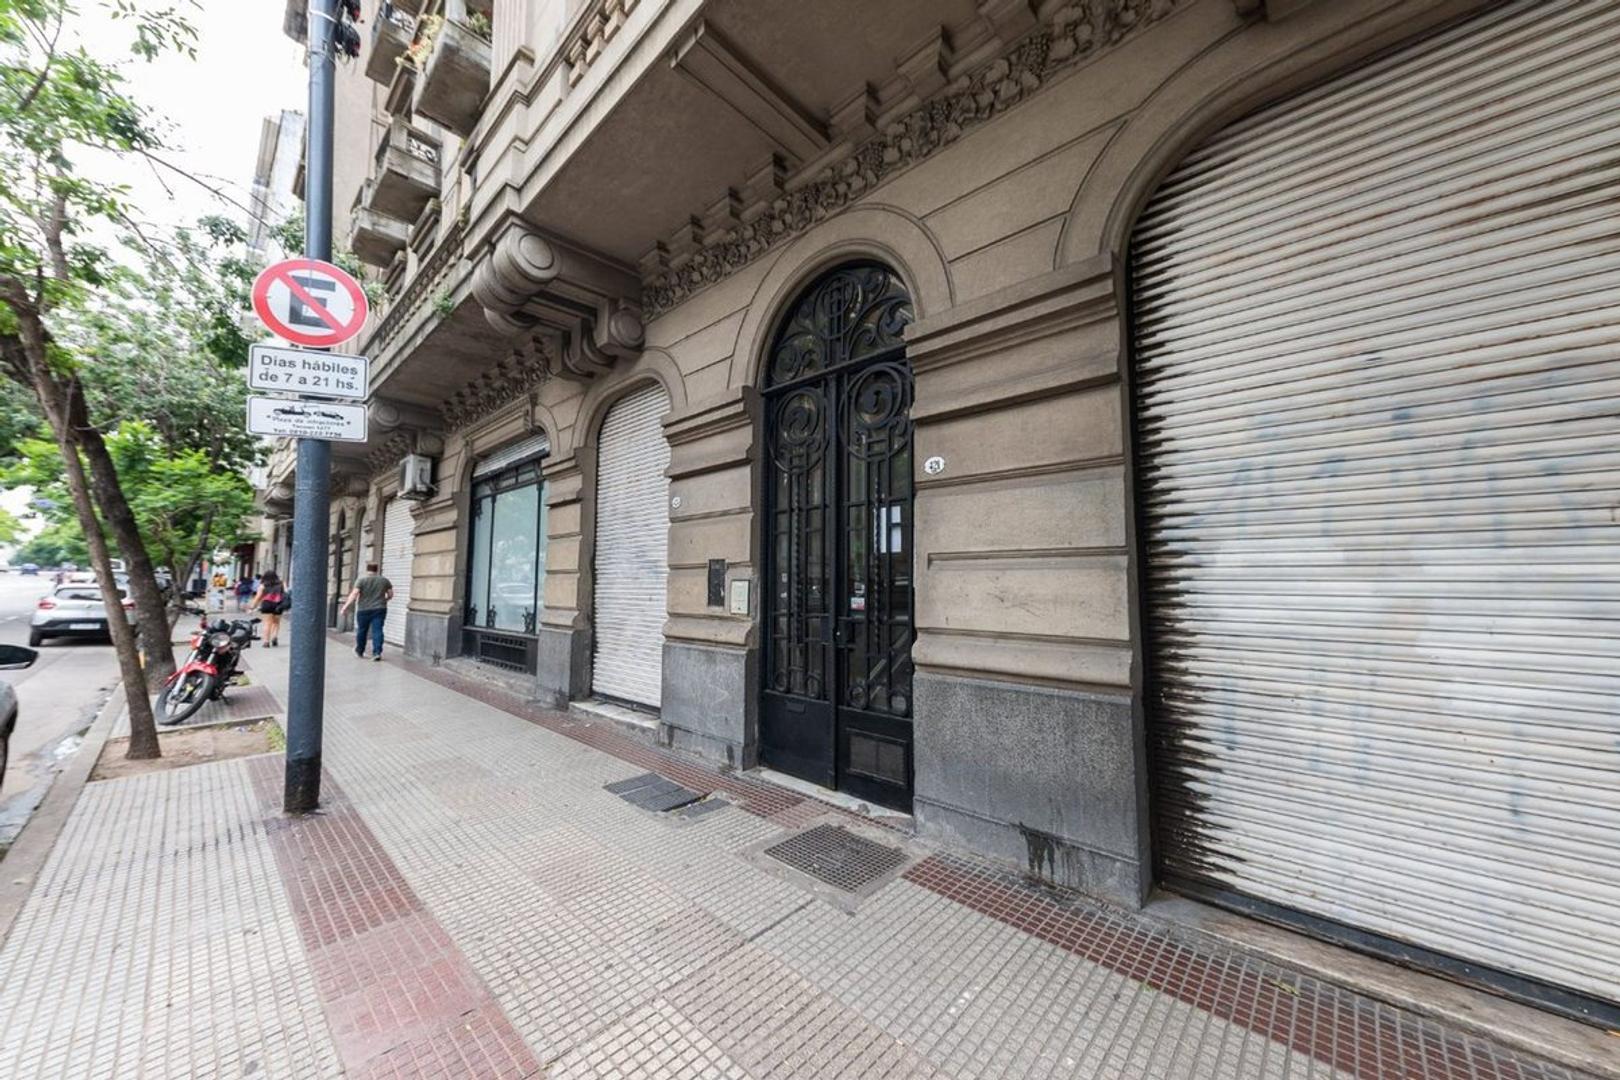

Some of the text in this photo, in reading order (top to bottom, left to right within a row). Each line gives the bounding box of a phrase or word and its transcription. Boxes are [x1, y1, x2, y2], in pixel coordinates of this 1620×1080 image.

[289, 275, 336, 329] E
[302, 359, 358, 375] hábiles
[259, 369, 359, 391] de 7 a 21 hs.
